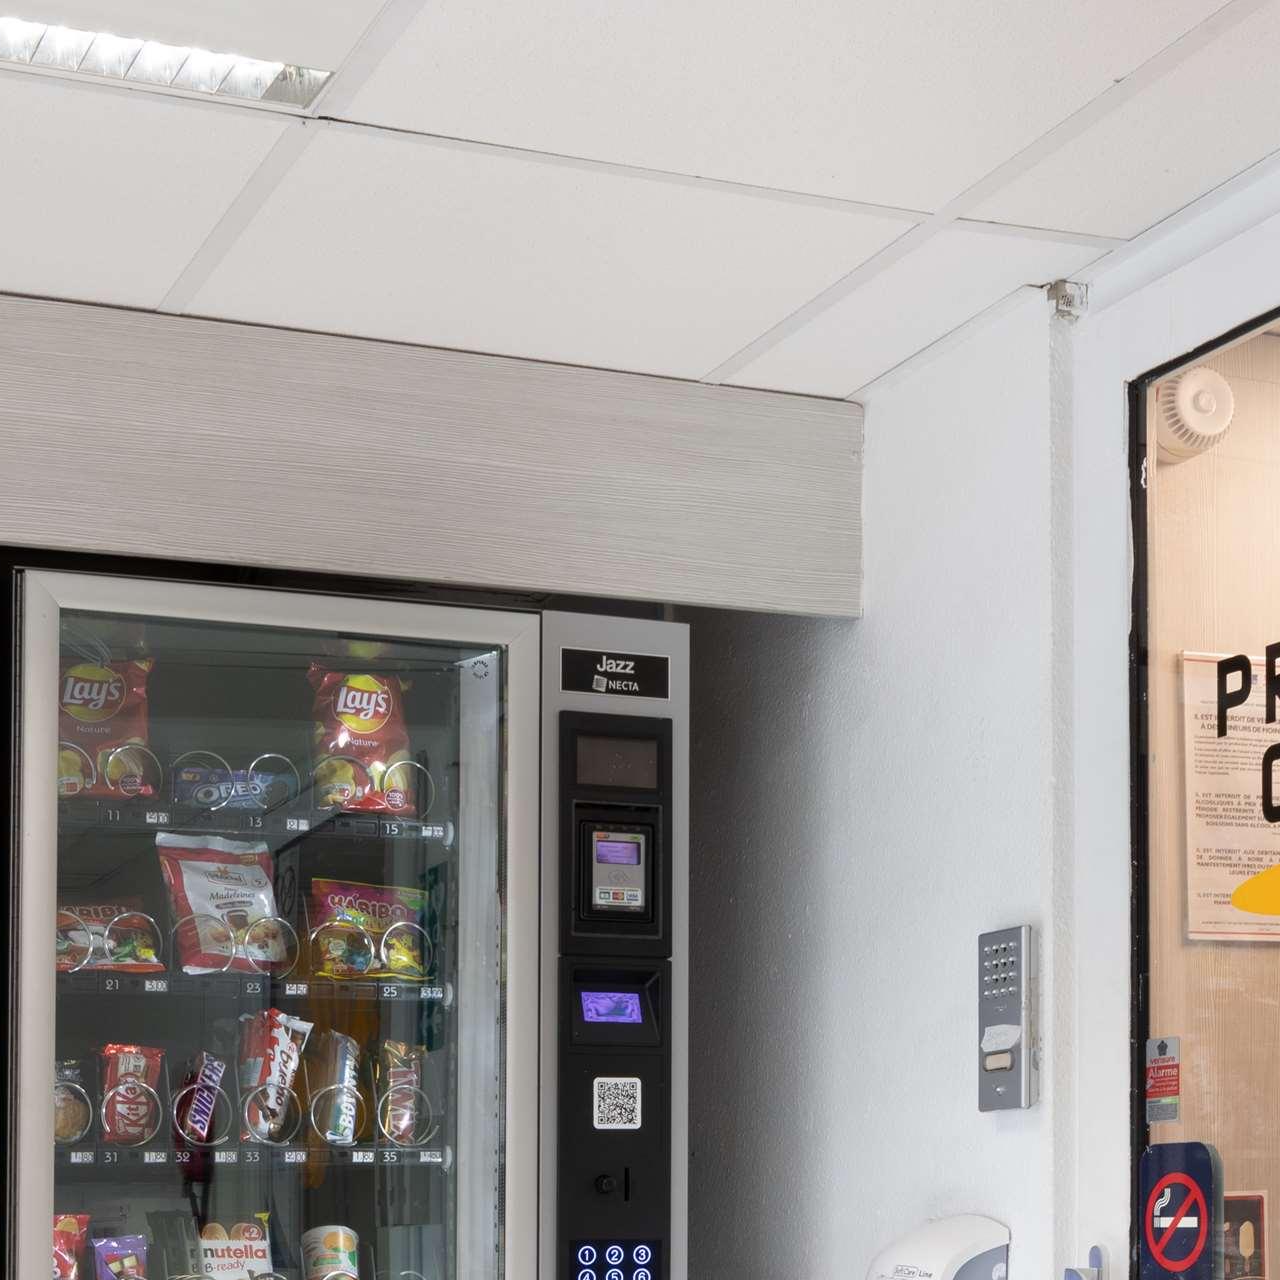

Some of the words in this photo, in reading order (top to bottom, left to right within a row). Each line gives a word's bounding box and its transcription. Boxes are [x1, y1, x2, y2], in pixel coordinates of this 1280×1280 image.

[596, 655, 635, 674] Jazz
[608, 680, 640, 692] NECTA
[108, 810, 120, 821] 11
[250, 817, 262, 828] 13
[385, 823, 398, 834] 15
[106, 979, 119, 990] 21
[246, 982, 261, 993] 23
[383, 986, 397, 996] 25
[1148, 1067, 1178, 1078] Alarme
[104, 1153, 118, 1163] 31
[175, 1153, 190, 1162] 32
[245, 1152, 260, 1161] 33
[383, 1152, 397, 1161] 35
[204, 1246, 267, 1260] nutella
